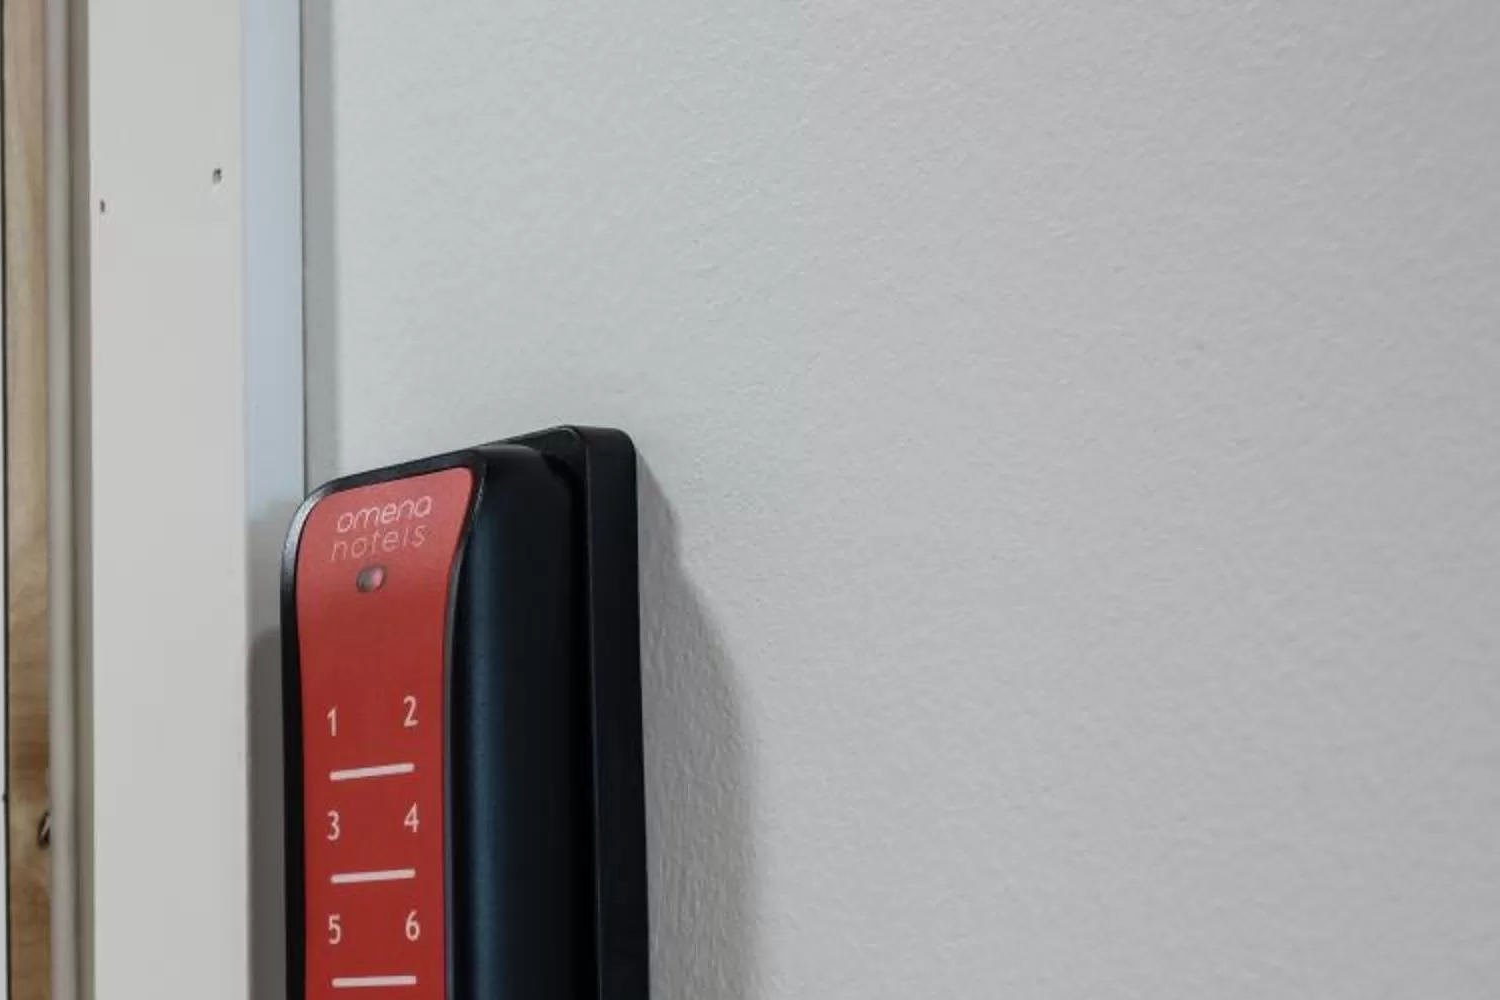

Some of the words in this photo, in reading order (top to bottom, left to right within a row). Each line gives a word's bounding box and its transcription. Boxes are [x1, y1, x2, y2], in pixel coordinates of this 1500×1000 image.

[335, 494, 434, 534] omena
[327, 706, 338, 737] 1
[403, 695, 419, 728] 2
[327, 810, 341, 842] 3
[403, 801, 420, 834] 4
[328, 914, 341, 945] 5
[405, 910, 421, 942] 6
